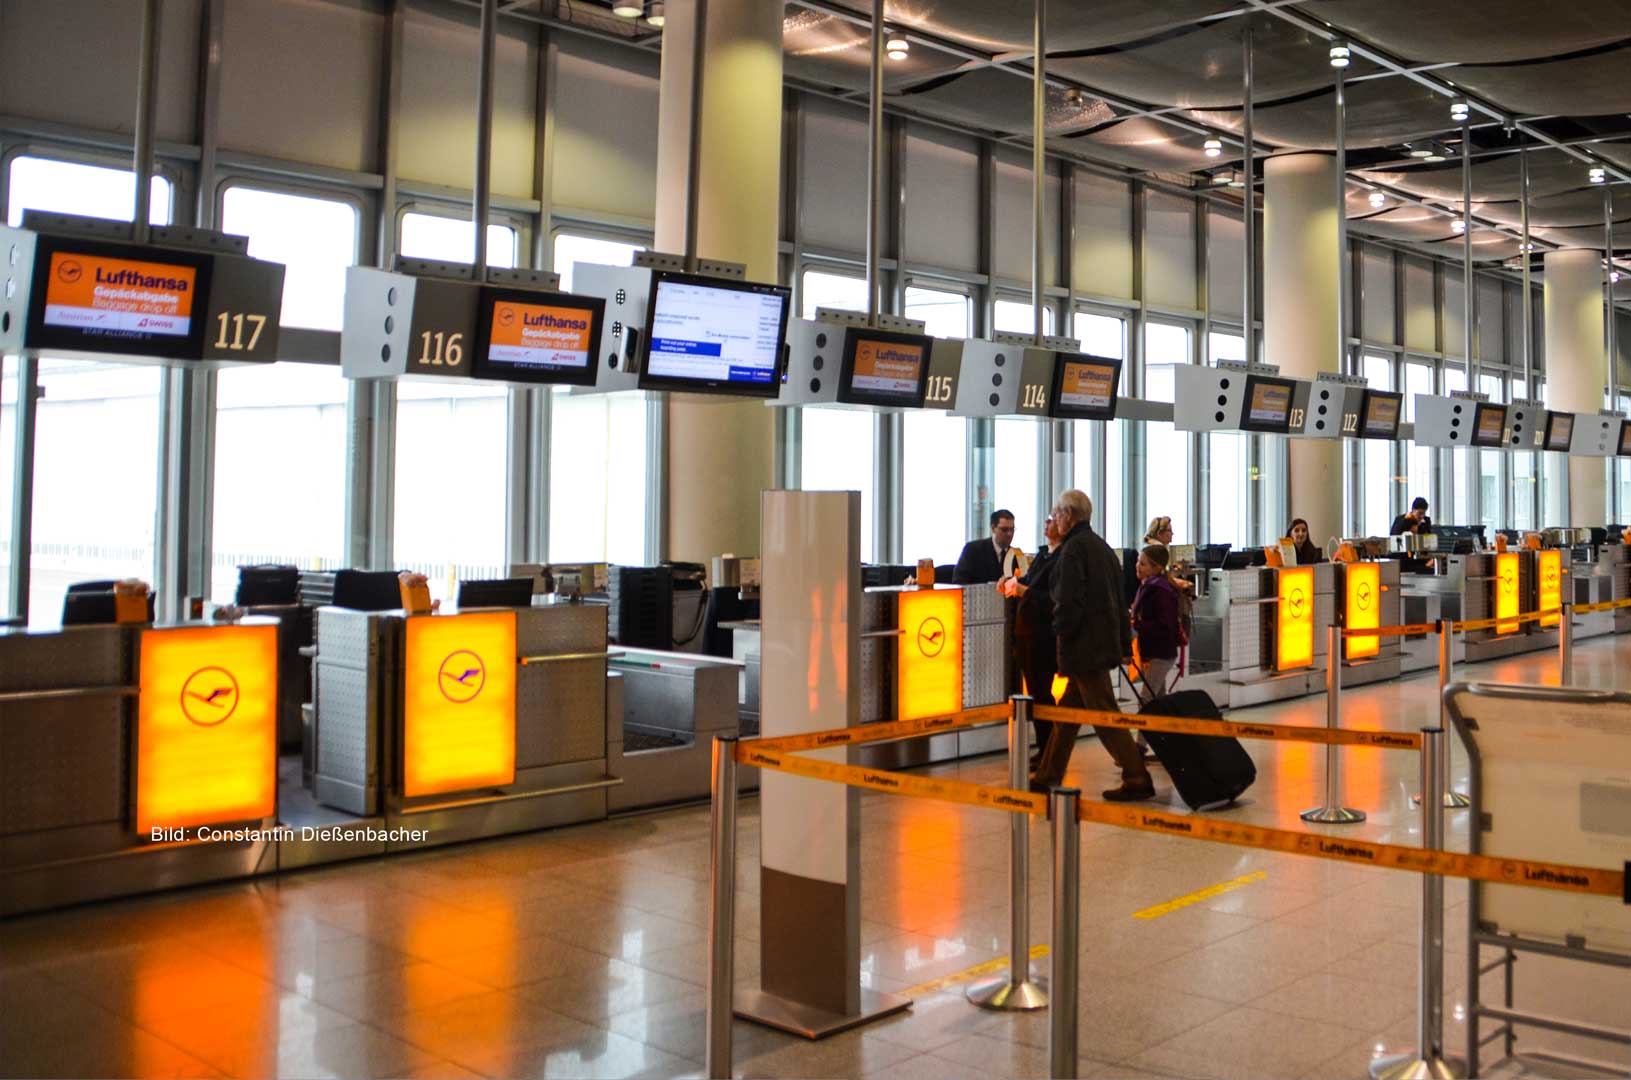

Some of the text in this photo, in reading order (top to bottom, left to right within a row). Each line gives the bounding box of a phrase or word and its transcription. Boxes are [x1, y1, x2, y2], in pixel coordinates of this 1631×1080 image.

[95, 267, 188, 291] Lufthansa
[523, 312, 588, 331] Lufthansa
[214, 311, 267, 351] 117
[418, 330, 464, 367] 116
[876, 348, 919, 362] Lufthansa
[925, 376, 952, 401] 115
[1023, 384, 1046, 408] 114
[1289, 408, 1304, 427] 113
[1343, 413, 1358, 432] 112
[924, 718, 951, 729] Lufthansa
[1111, 716, 1147, 726] Lufthansa
[816, 733, 850, 745] Lufthansa
[1236, 727, 1275, 737] Lufthansa
[1371, 735, 1414, 747] Lufthansa
[750, 753, 781, 766] Lufthansa
[863, 773, 899, 788] Lufthansa
[992, 793, 1034, 809] Lufthansa
[1142, 815, 1192, 832] Lufthansa
[1319, 840, 1374, 859] Lufthansa
[1524, 869, 1590, 887] Lufthansa
